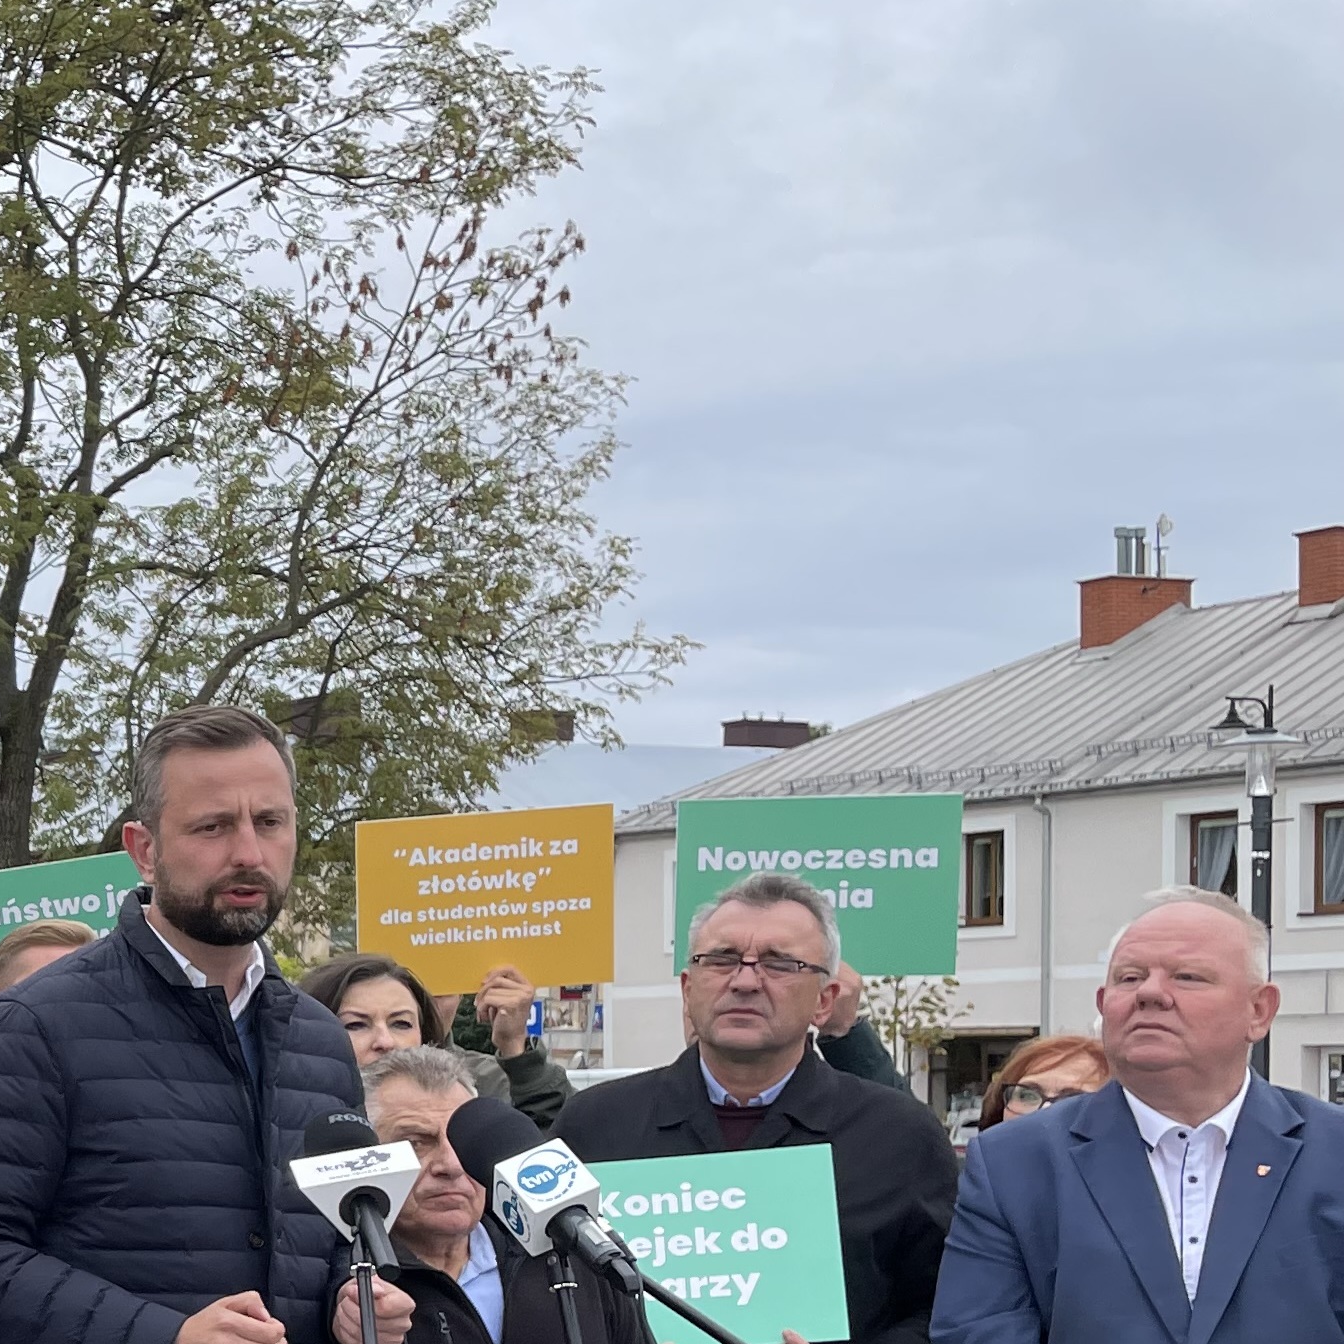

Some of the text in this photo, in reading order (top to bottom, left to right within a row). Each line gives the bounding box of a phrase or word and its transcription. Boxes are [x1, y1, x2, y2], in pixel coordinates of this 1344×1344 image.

[549, 838, 579, 856] za
[697, 846, 939, 873] Nowoczesna
[379, 897, 592, 925] dla studentów spoza
[410, 919, 562, 946] wielkich miast
[598, 1181, 746, 1218] Koniec
[623, 1222, 788, 1267] ejek do
[656, 1272, 761, 1306] arzy
